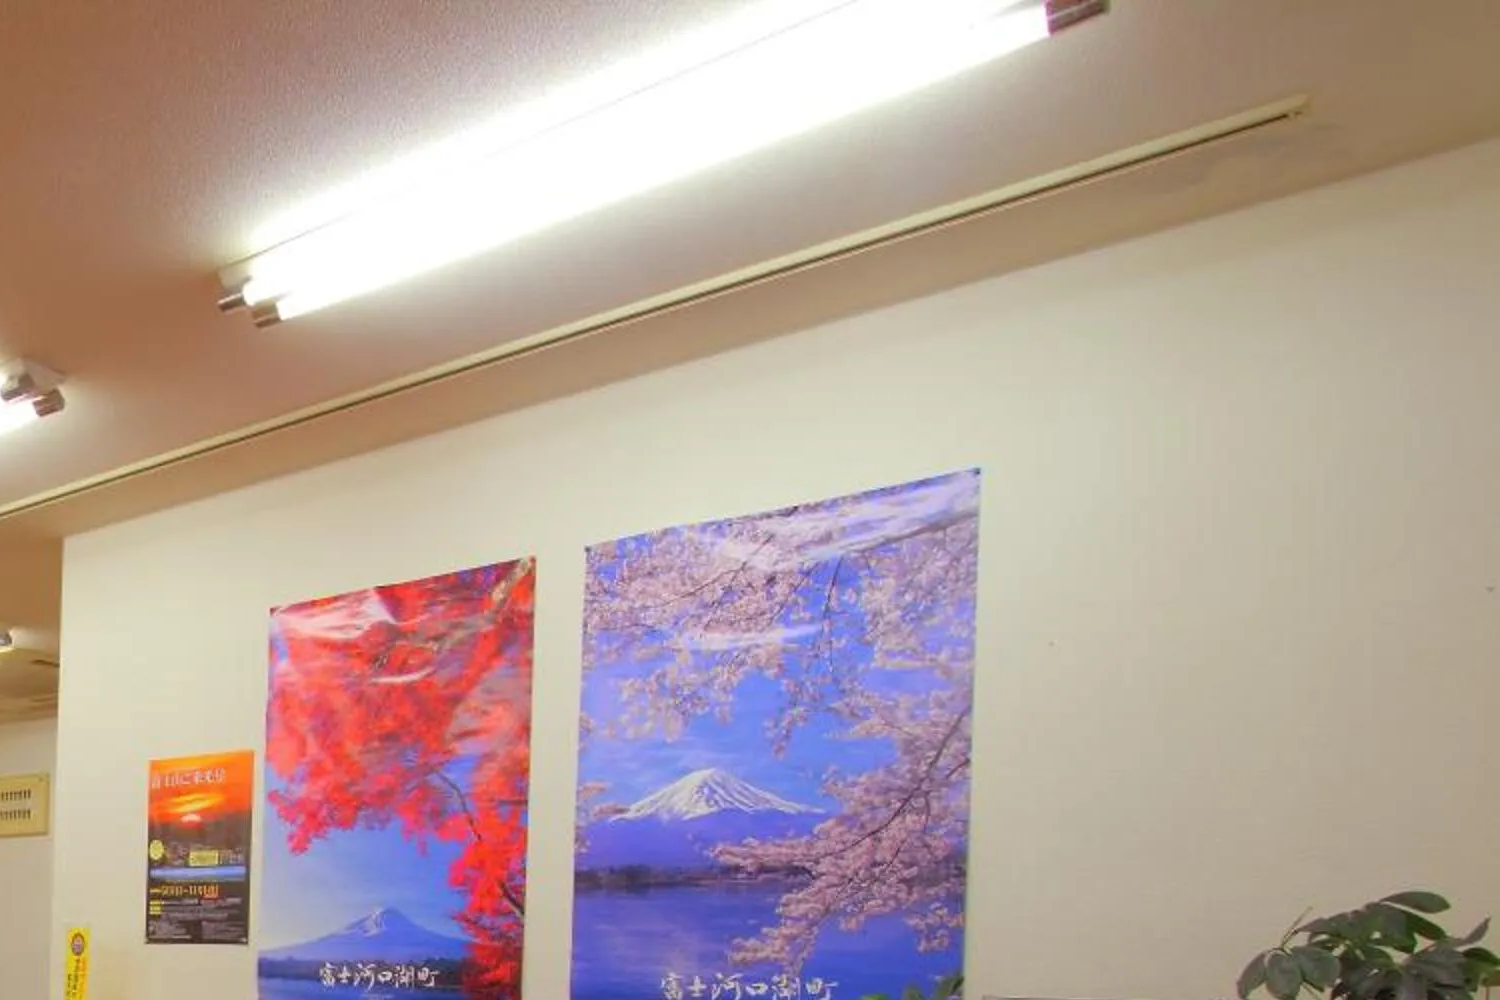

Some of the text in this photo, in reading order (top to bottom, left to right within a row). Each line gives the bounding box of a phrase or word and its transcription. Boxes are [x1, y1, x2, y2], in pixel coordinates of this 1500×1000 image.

[319, 962, 439, 990] 富士河口湖町
